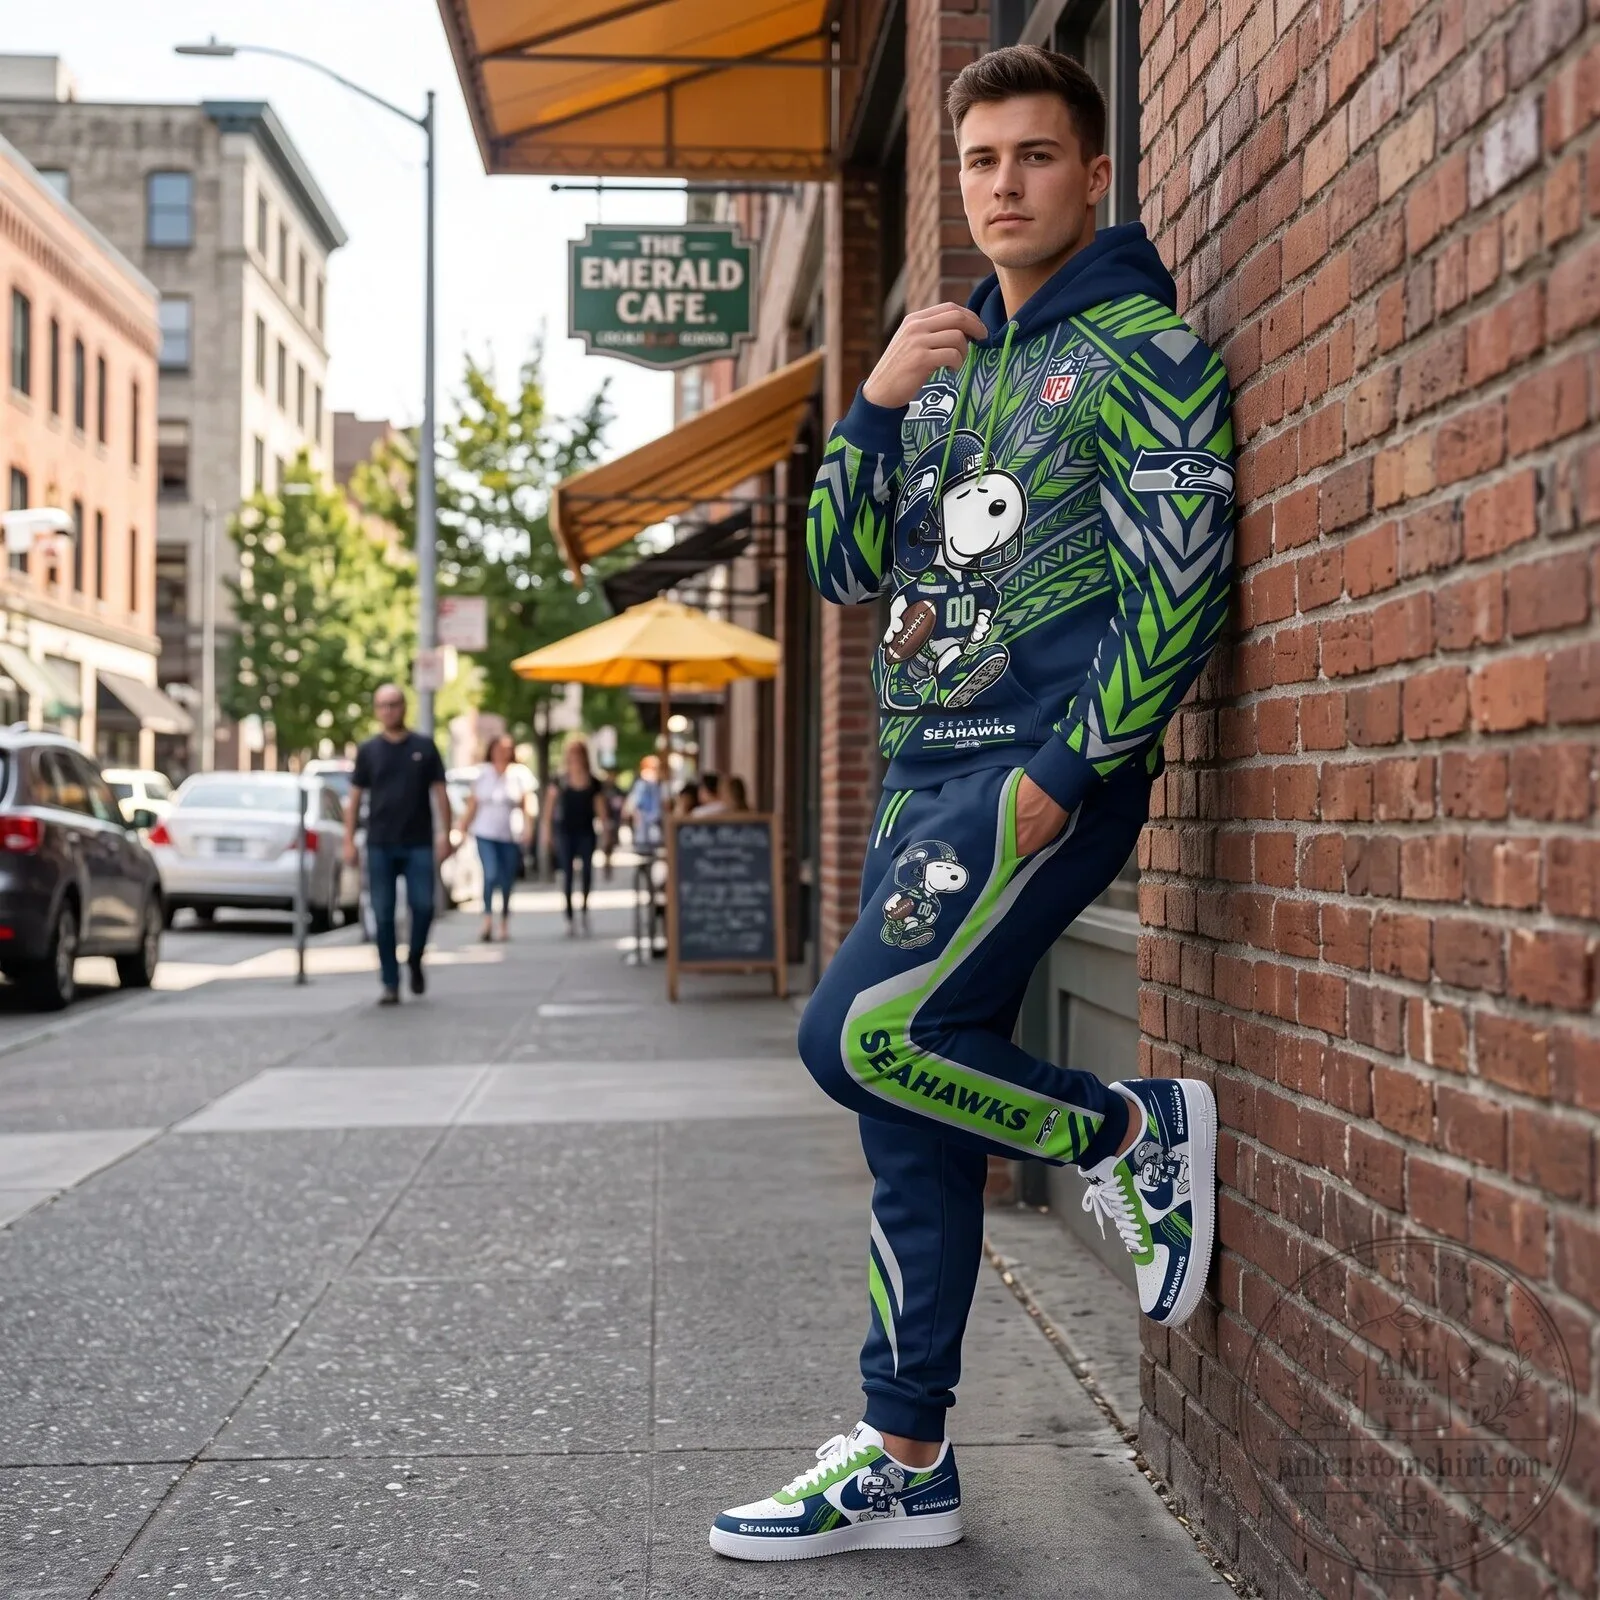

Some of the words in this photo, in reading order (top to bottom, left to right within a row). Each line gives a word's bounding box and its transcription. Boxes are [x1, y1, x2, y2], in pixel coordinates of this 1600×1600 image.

[639, 234, 686, 257] THE
[581, 256, 744, 291] EMERALD
[1042, 376, 1072, 402] NFL
[945, 593, 976, 629] 00
[922, 724, 1017, 741] SEAHAWKS
[938, 717, 1000, 728] SEATTLE
[860, 1029, 1031, 1131] SEAHAWKS
[912, 1497, 959, 1512] SEAHAWKS
[739, 1523, 800, 1534] SEAHAWKS
